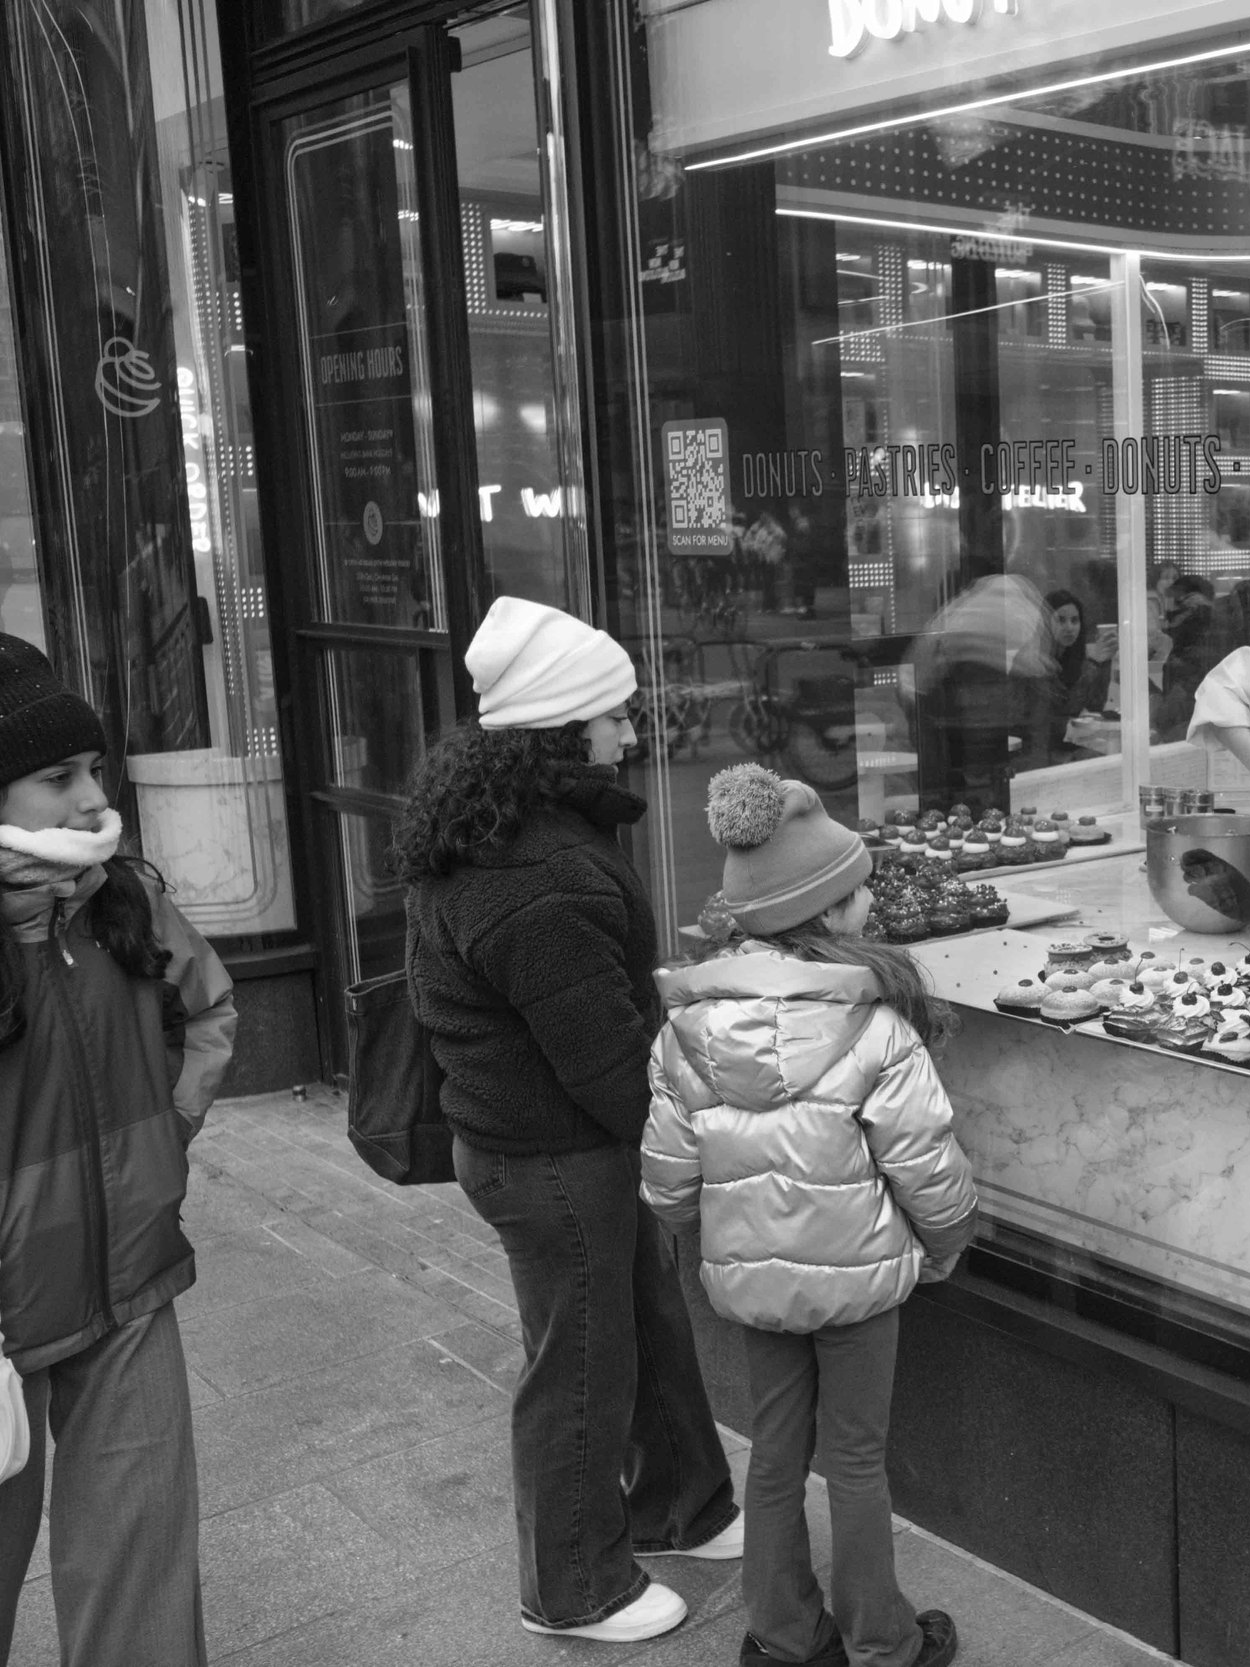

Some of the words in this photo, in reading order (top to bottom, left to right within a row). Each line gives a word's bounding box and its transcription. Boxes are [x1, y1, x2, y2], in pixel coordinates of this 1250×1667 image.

[320, 350, 365, 384] OPENING
[367, 346, 404, 379] HOURS
[742, 450, 823, 498] DONUTS
[843, 443, 956, 497] PASTRIES
[980, 438, 1076, 495] COFFEE
[1102, 434, 1222, 495] DONUTS
[672, 535, 691, 546] SCAN
[692, 535, 706, 546] FOR
[707, 535, 728, 546] MENU
